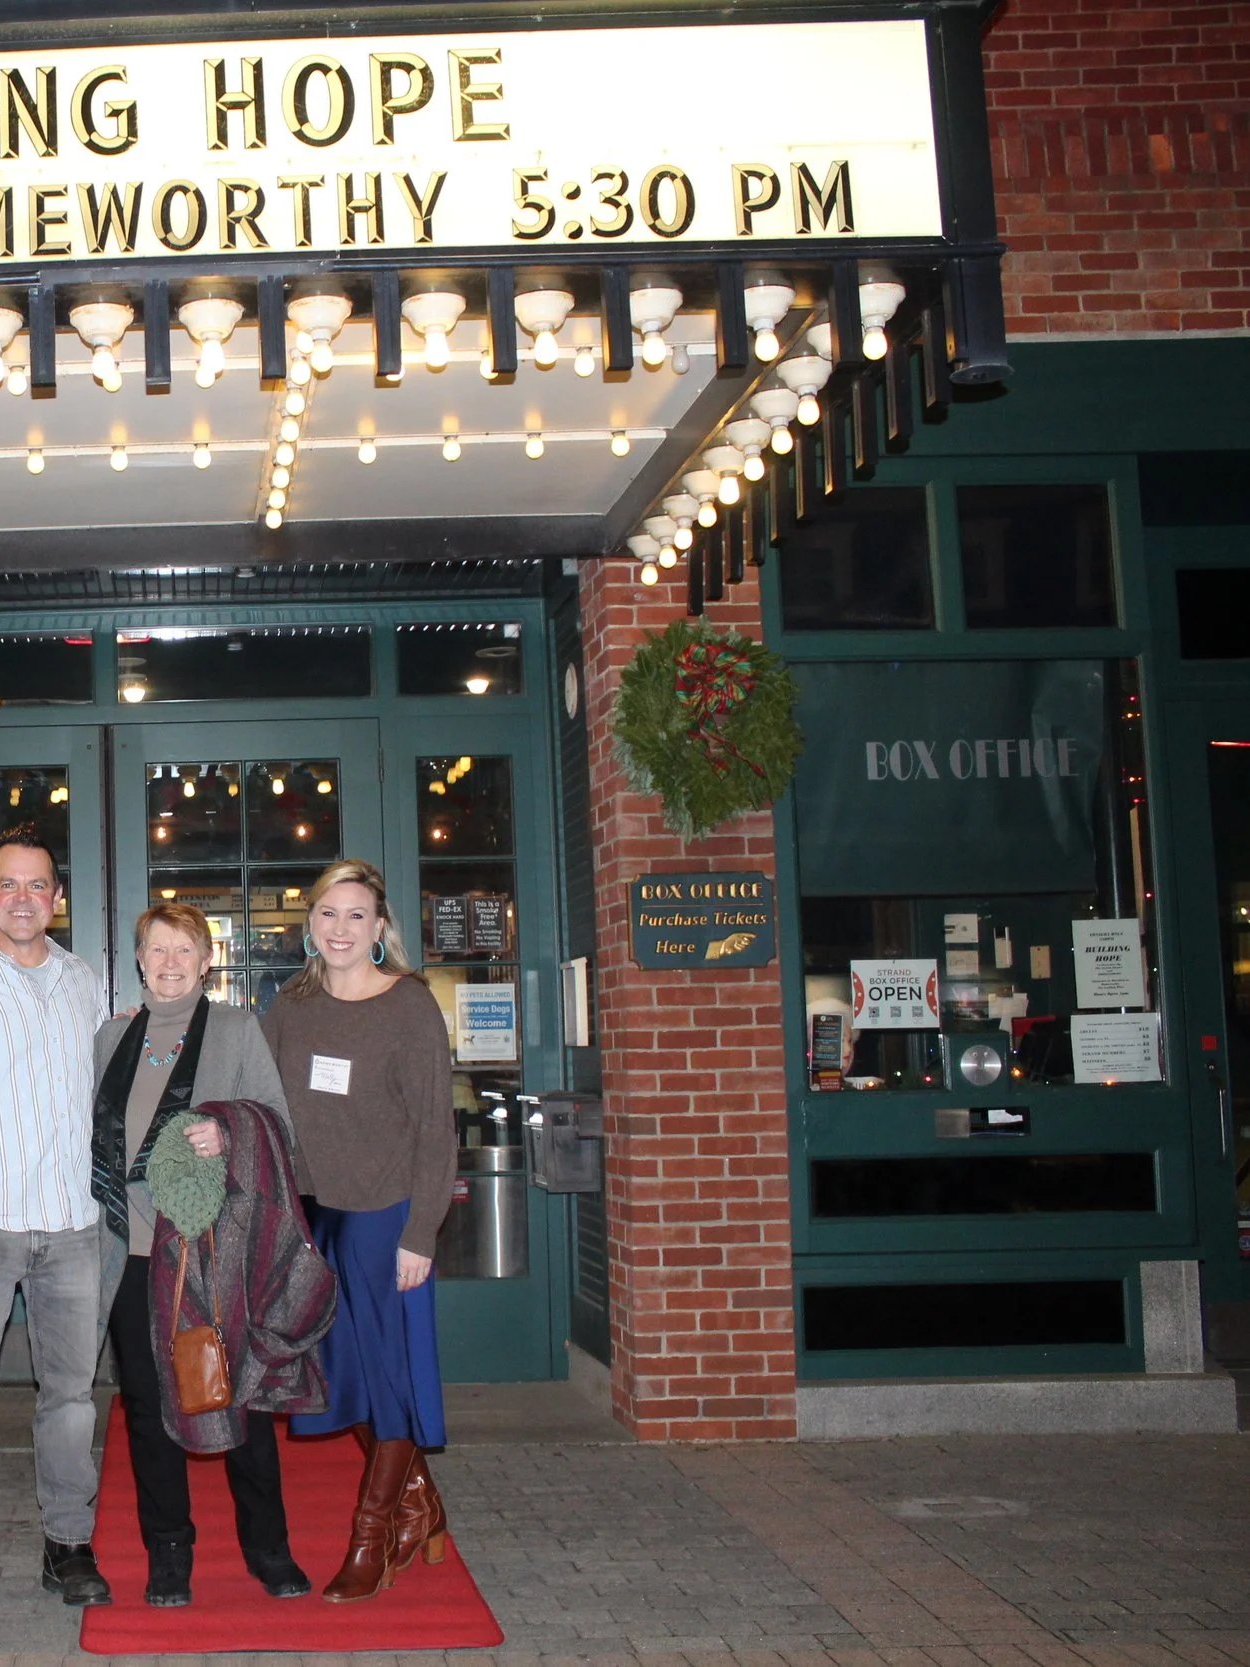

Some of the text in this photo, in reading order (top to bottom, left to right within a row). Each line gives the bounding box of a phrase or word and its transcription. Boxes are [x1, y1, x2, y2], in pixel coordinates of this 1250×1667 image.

[204, 48, 510, 151] HOPE
[512, 164, 695, 240] 5:30
[732, 160, 854, 235] PM
[866, 738, 1079, 781] BOX OFFICE
[641, 882, 764, 900] BOX OFFICE
[639, 911, 767, 926] Purchase Tickets
[656, 940, 696, 954] Here
[1085, 945, 1130, 953] BUILDING
[869, 986, 921, 1001] OPEN
[462, 1005, 510, 1014] Service Dogs
[466, 1019, 507, 1027] Welcome
